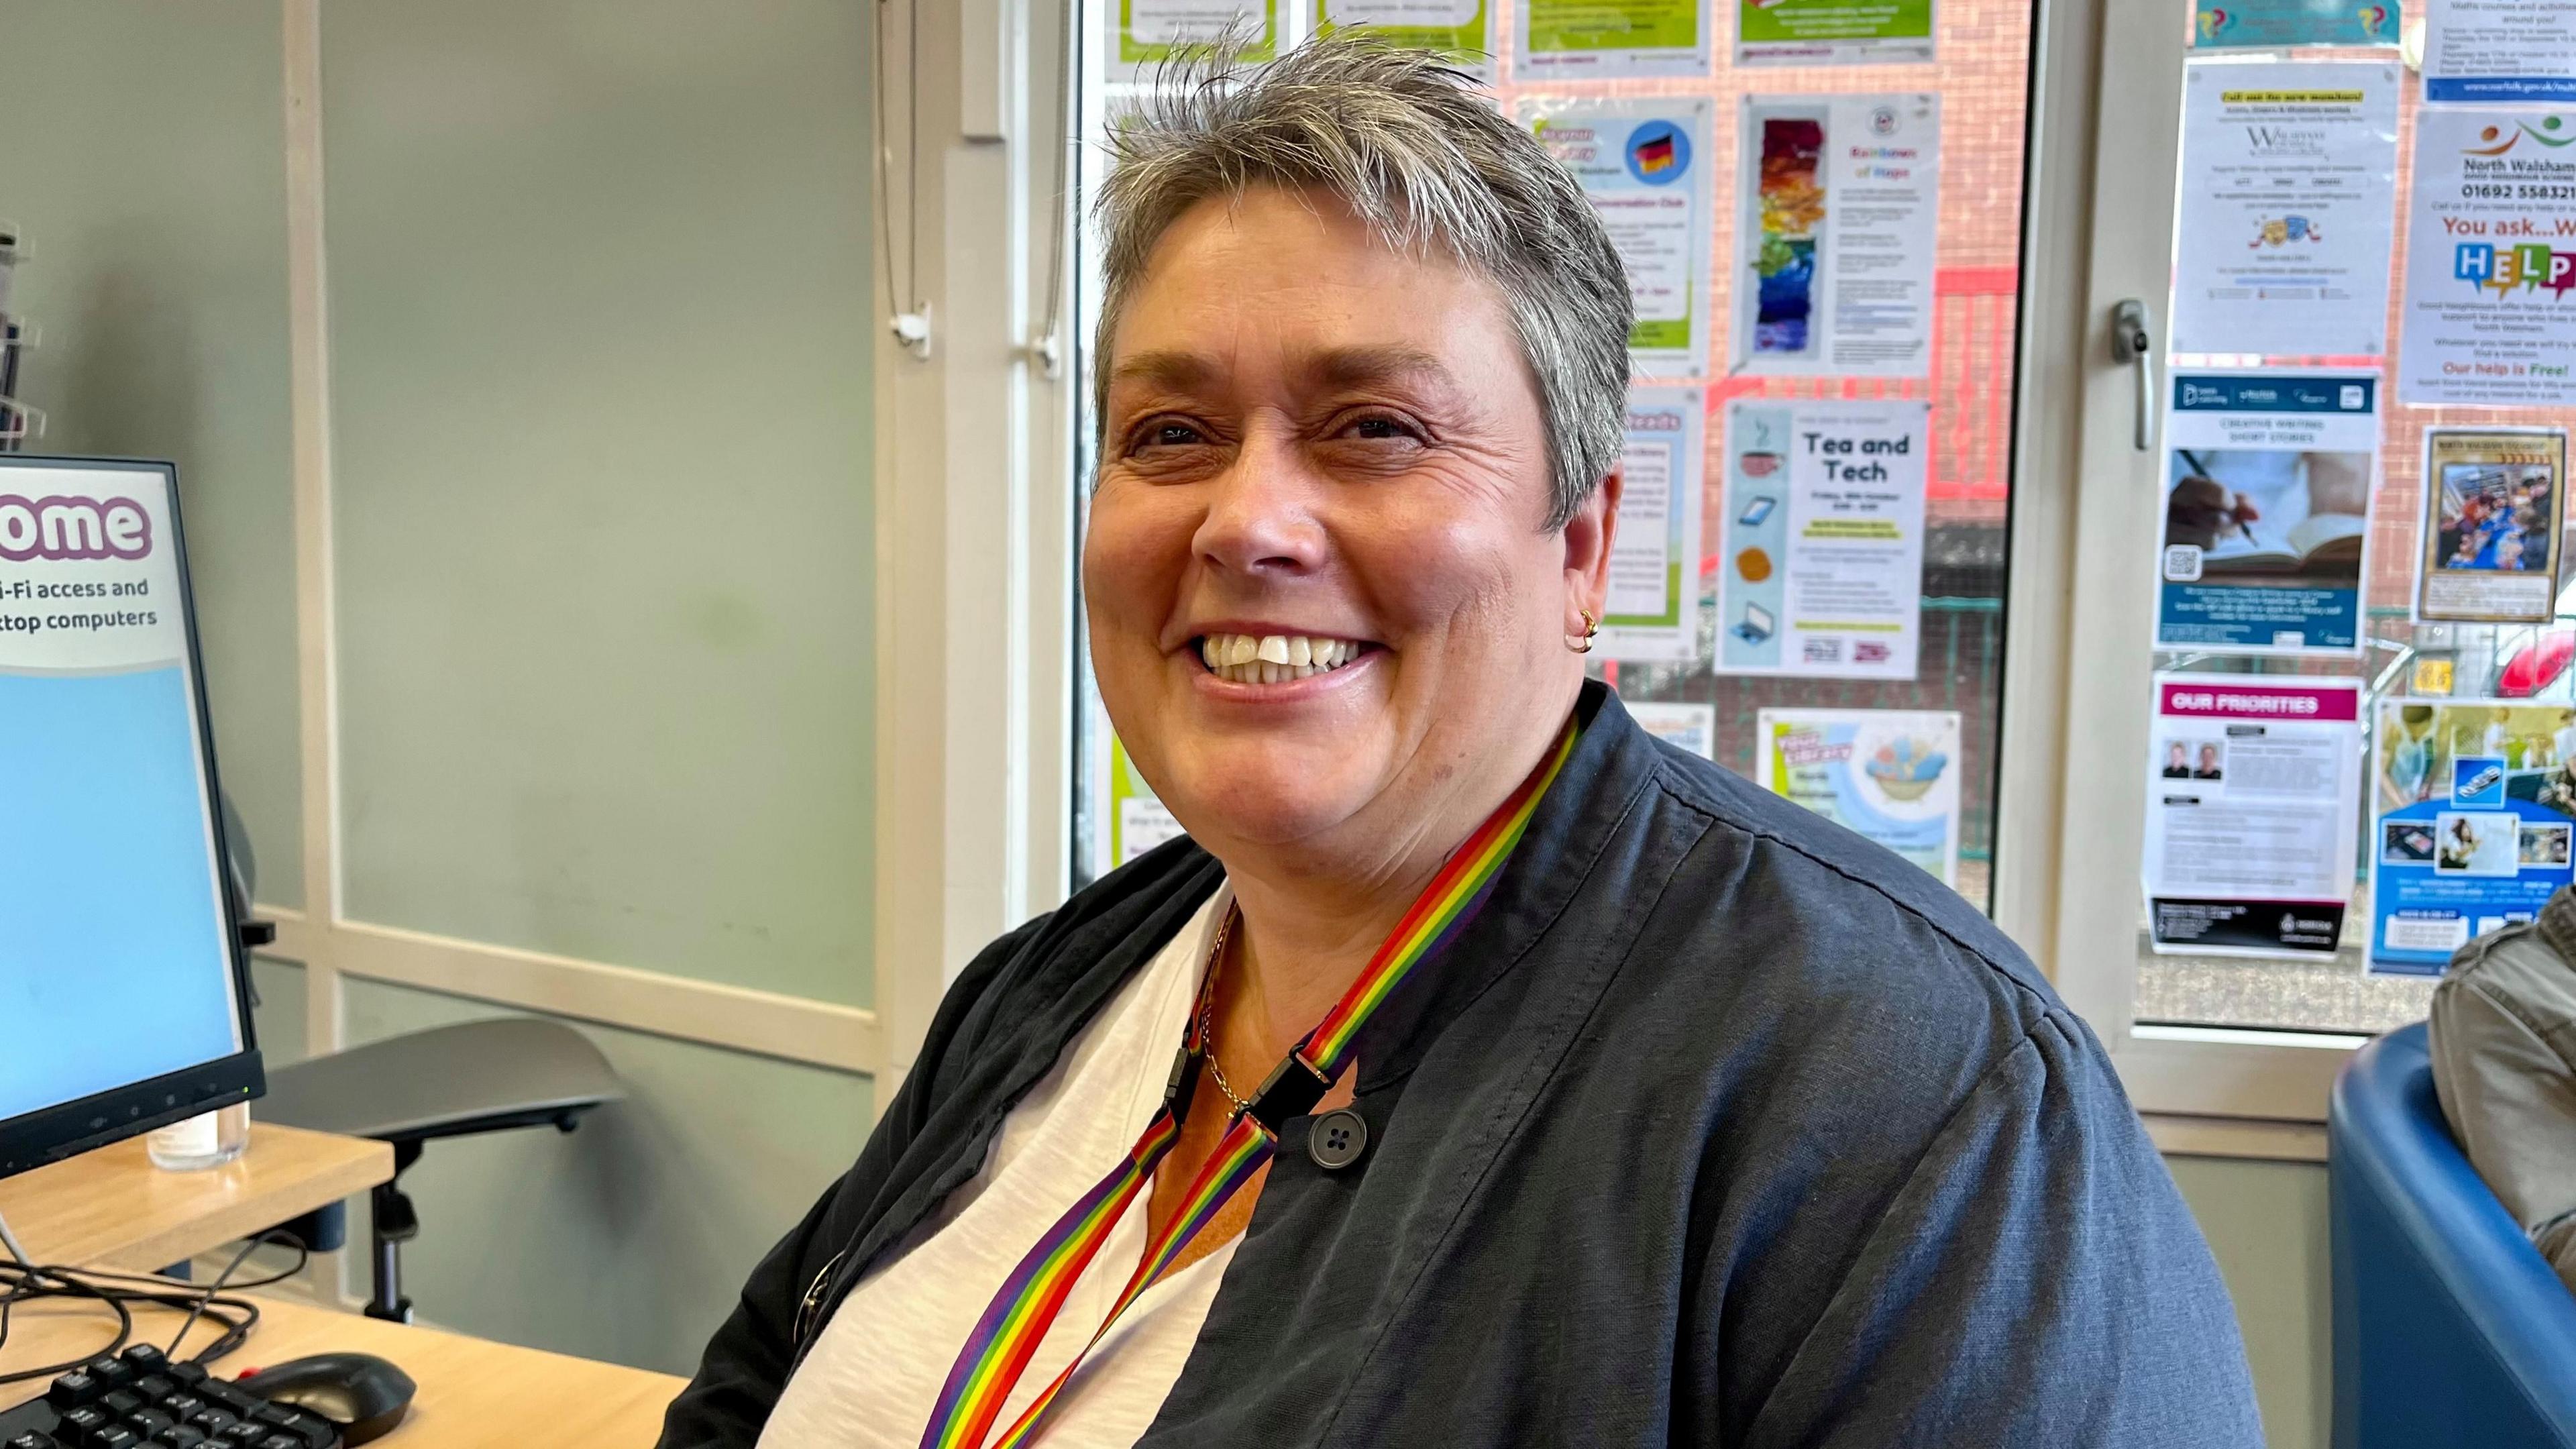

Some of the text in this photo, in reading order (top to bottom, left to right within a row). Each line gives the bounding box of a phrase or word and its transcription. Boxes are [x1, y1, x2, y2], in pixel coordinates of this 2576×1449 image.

[2482, 3, 2516, 12] courses
[2520, 3, 2536, 12] and
[2502, 16, 2534, 24] around
[1849, 146, 1917, 160] Rainbows
[1855, 166, 1911, 181] of Hope
[2464, 159, 2576, 172] North Walsham
[2461, 184, 2576, 200] 01692 558321
[2443, 217, 2487, 236] You
[2460, 246, 2571, 284] HELP
[2473, 323, 2500, 332] North
[2443, 361, 2569, 378] Our help is Free!
[2219, 417, 2326, 431] CREATIVE WRITING
[1801, 432, 1910, 455] Tea and
[2229, 432, 2316, 443] SHORT STORIES
[1821, 458, 1888, 482] Tech
[37, 583, 107, 599] access
[112, 578, 150, 596] and
[46, 610, 158, 633] computers
[2171, 692, 2319, 714] OUR PRIORITIES
